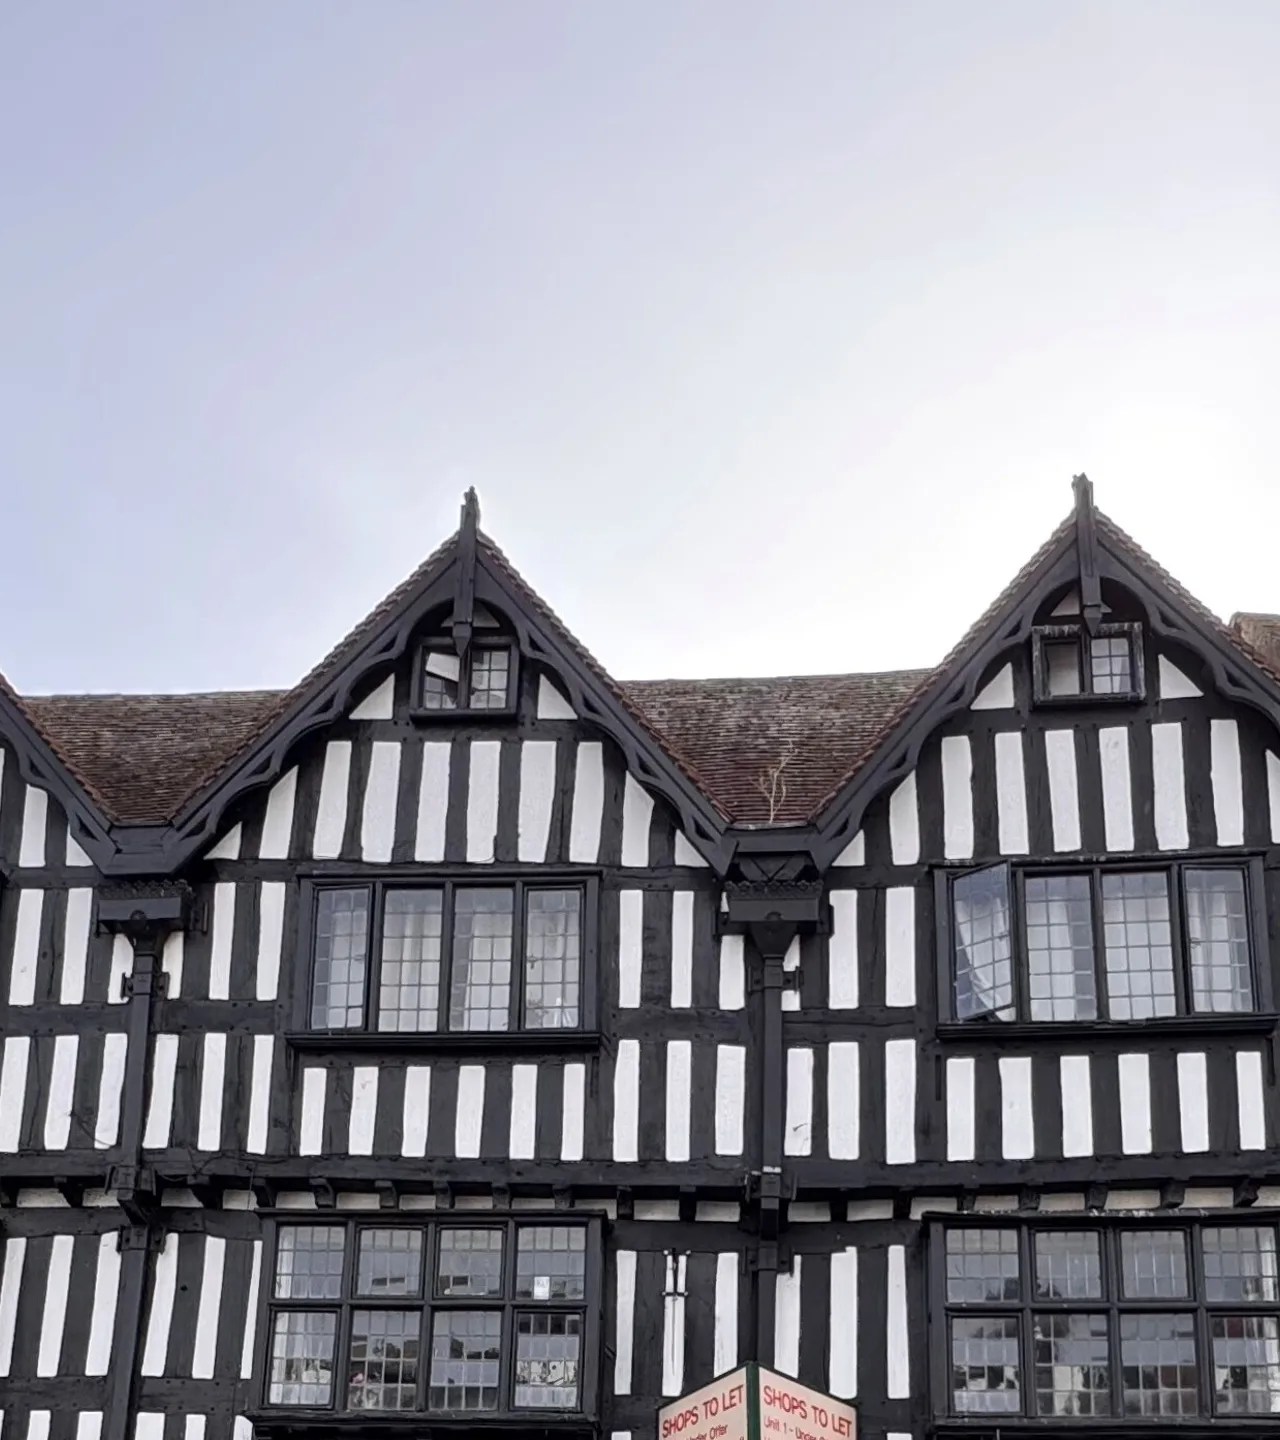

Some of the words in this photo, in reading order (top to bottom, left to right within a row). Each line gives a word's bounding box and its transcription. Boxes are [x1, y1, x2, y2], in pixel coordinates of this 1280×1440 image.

[662, 1406, 699, 1438] SHOPS
[702, 1396, 719, 1420] TO
[722, 1384, 744, 1411] LET
[763, 1385, 808, 1420] SHOPS
[811, 1405, 828, 1428] TO
[831, 1413, 852, 1438] LET
[764, 1415, 780, 1432] Unit
[783, 1422, 787, 1434] 1
[709, 1424, 728, 1440] Offer
